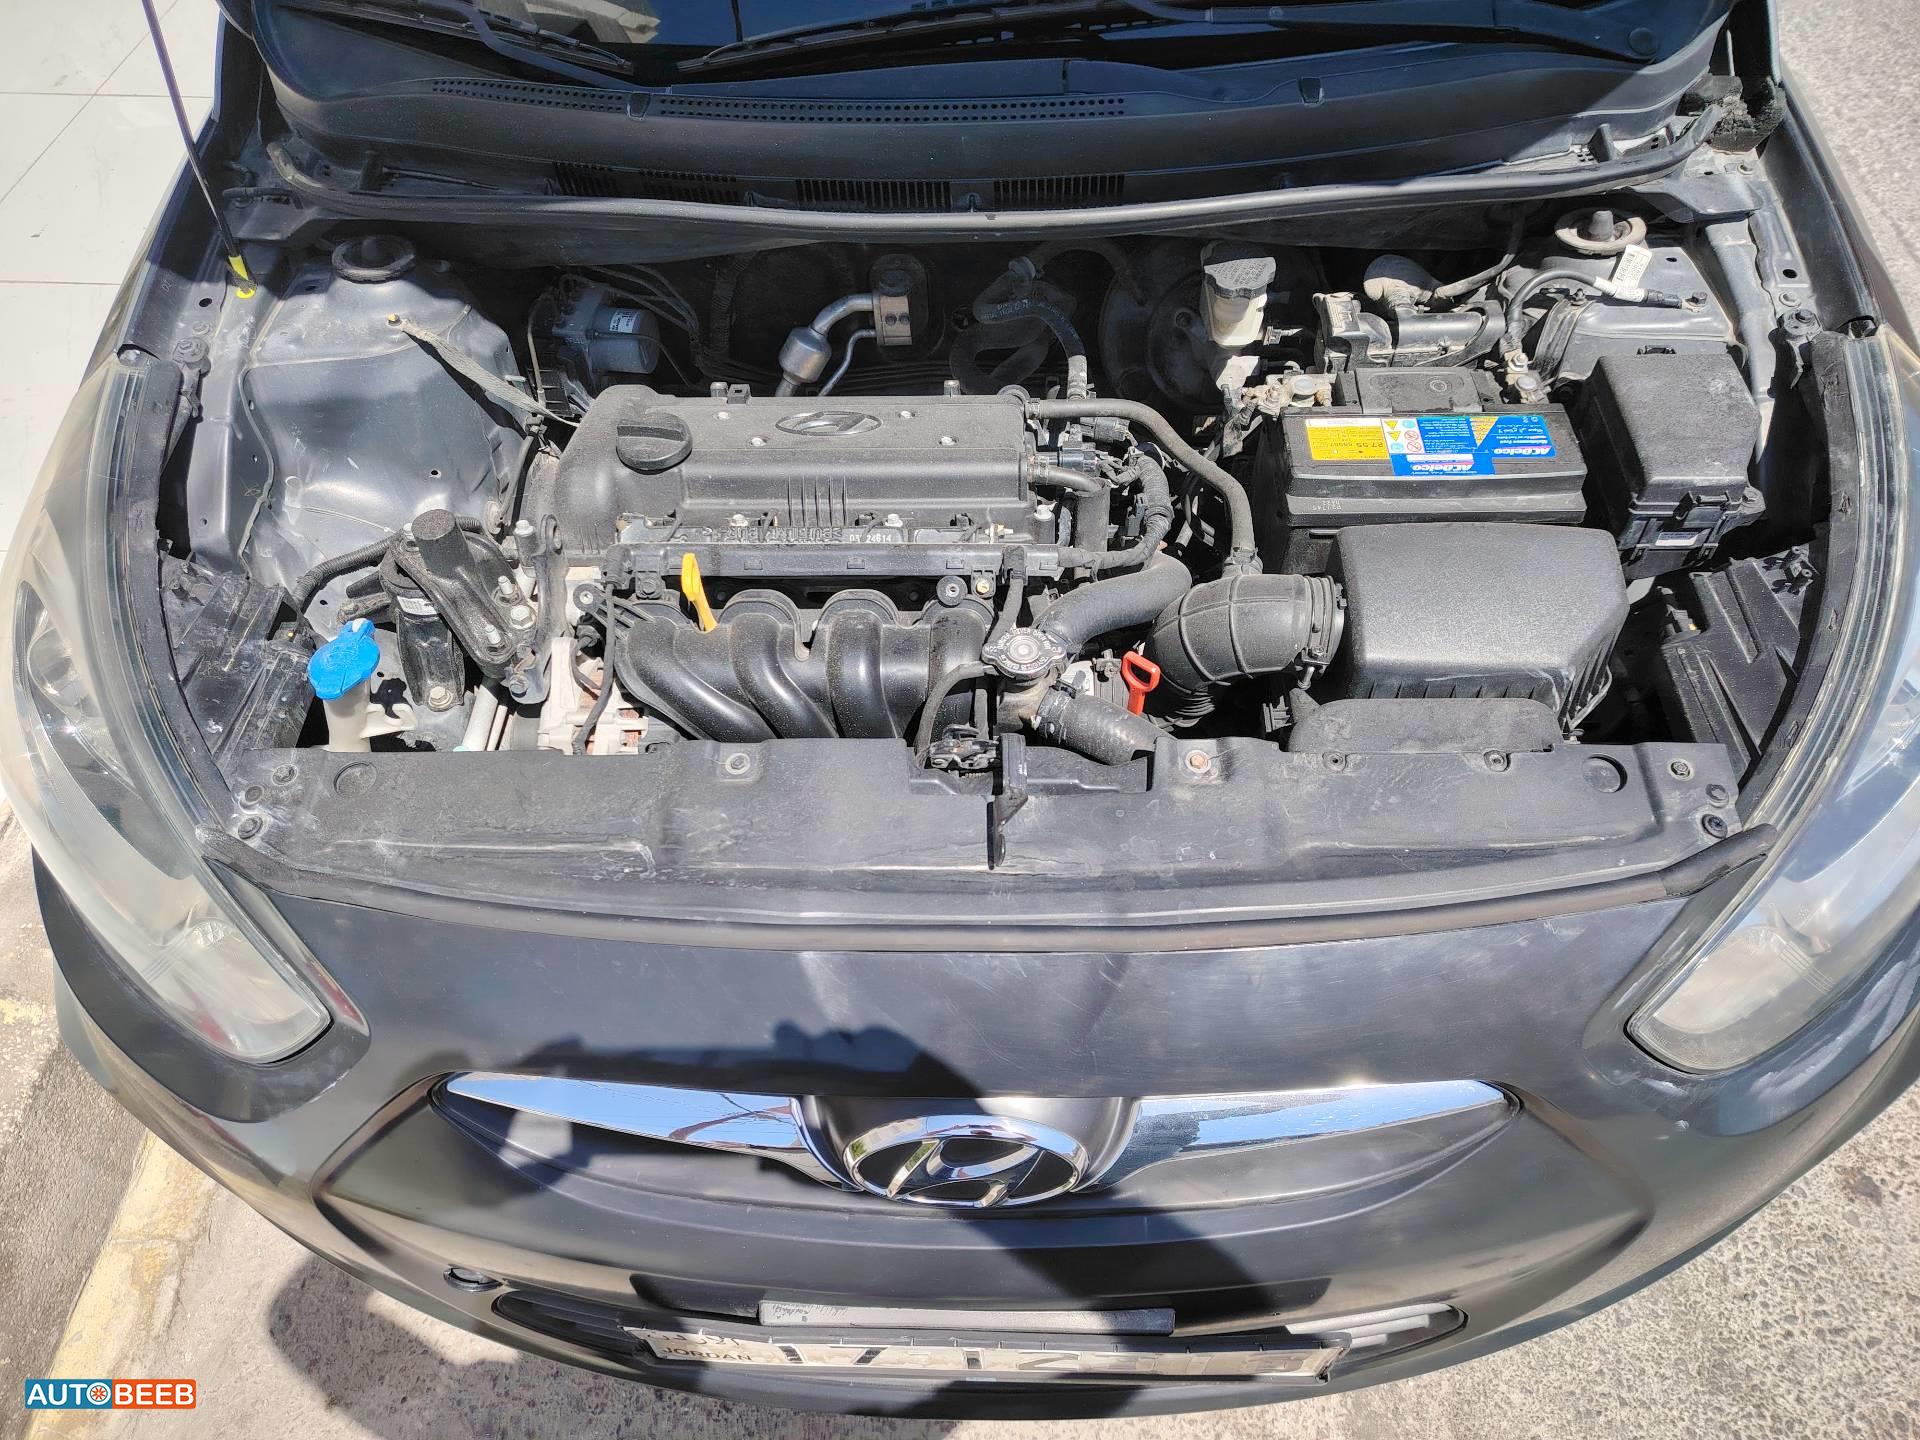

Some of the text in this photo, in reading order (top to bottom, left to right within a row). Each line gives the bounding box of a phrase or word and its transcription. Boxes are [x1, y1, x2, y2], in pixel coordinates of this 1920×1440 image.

[1493, 446, 1551, 455] ACDelco
[1412, 463, 1473, 471] ACDelco
[662, 1346, 752, 1361] JORDAN
